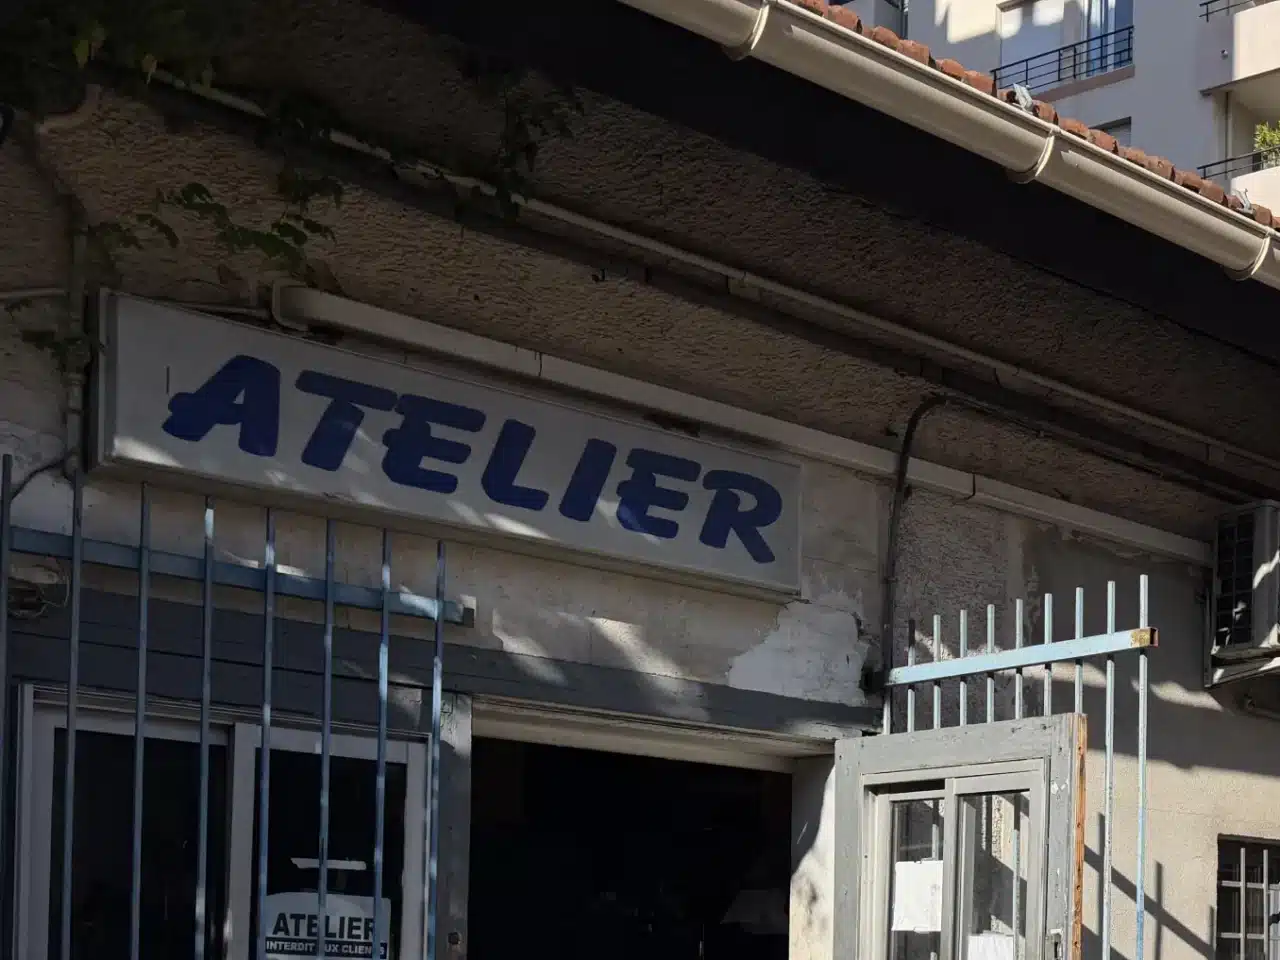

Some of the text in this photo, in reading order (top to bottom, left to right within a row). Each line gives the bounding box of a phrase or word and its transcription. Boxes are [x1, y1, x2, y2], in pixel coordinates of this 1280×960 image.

[162, 355, 783, 564] ATELIER
[272, 913, 375, 940] ATELIER
[266, 941, 316, 953] INTERDIT
[341, 944, 385, 956] CLIENS
